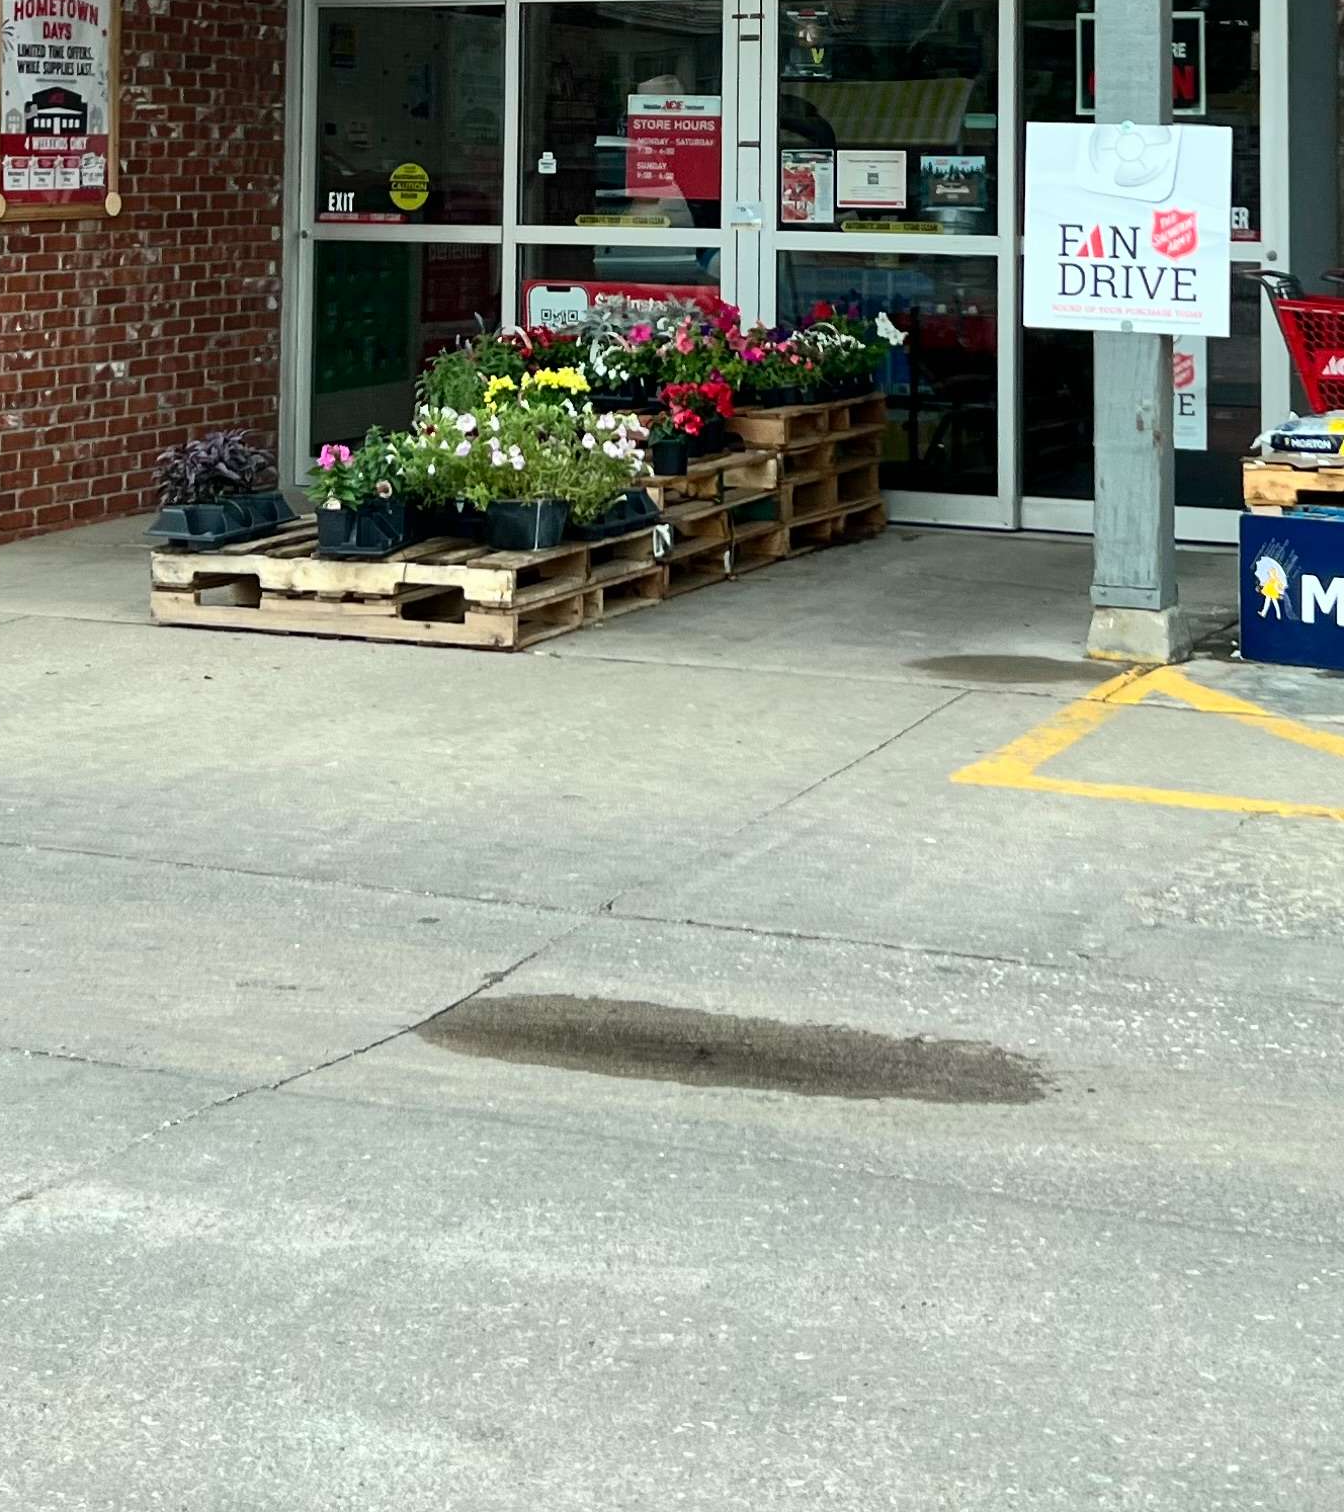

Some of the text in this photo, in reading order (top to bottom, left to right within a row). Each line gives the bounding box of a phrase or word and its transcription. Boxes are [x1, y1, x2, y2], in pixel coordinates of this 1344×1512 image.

[42, 21, 72, 40] DAYS
[17, 44, 46, 58] LIMITED
[48, 44, 64, 59] TIME
[16, 60, 40, 74] WHILE
[43, 61, 74, 76] SUPPLIES
[633, 119, 716, 131] STORE HOURS
[328, 192, 354, 212] EXIT
[1057, 262, 1197, 302] DRIVE
[1291, 437, 1331, 449] MORTON
